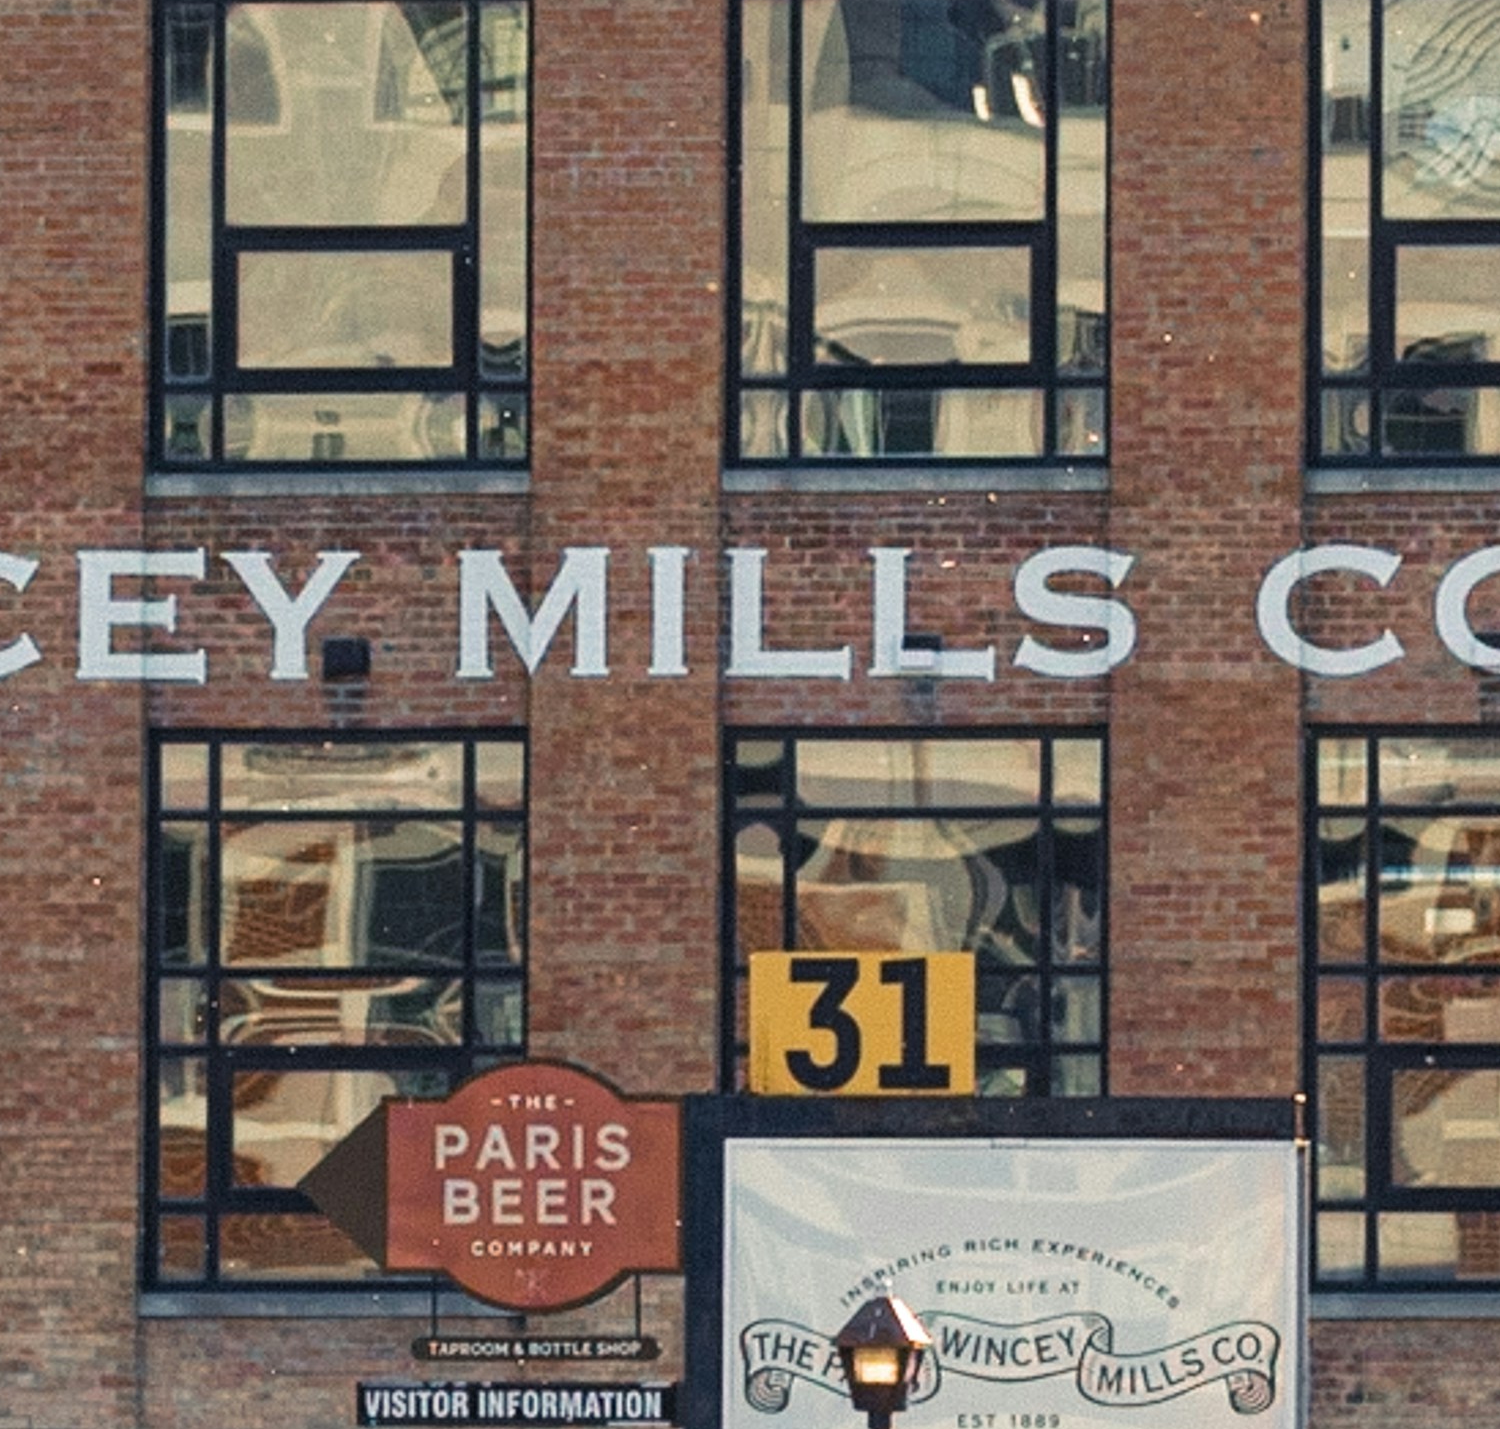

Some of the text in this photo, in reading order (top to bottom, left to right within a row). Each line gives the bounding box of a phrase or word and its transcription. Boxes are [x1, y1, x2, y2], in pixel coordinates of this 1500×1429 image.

[455, 545, 1137, 680] MILLS
[785, 957, 950, 1091] 31
[508, 1094, 558, 1110] THE
[434, 1124, 632, 1172] PARIS
[443, 1178, 618, 1225] BEER
[470, 1240, 594, 1257] COMPANY
[840, 1238, 1181, 1310] INSPIRING RICH EXPERIENCES
[935, 1280, 1081, 1295] ENJOY LIFE AT
[427, 1341, 509, 1356] TAPROOM
[528, 1341, 592, 1356] BOTTLE
[596, 1341, 642, 1356] SHOP
[752, 1332, 819, 1372] THE
[940, 1325, 1076, 1367] WINCEY
[1096, 1347, 1205, 1395] MILLS
[1211, 1332, 1264, 1365] CO.
[364, 1390, 662, 1420] VISITOR INFORMATION
[956, 1413, 996, 1429] EST
